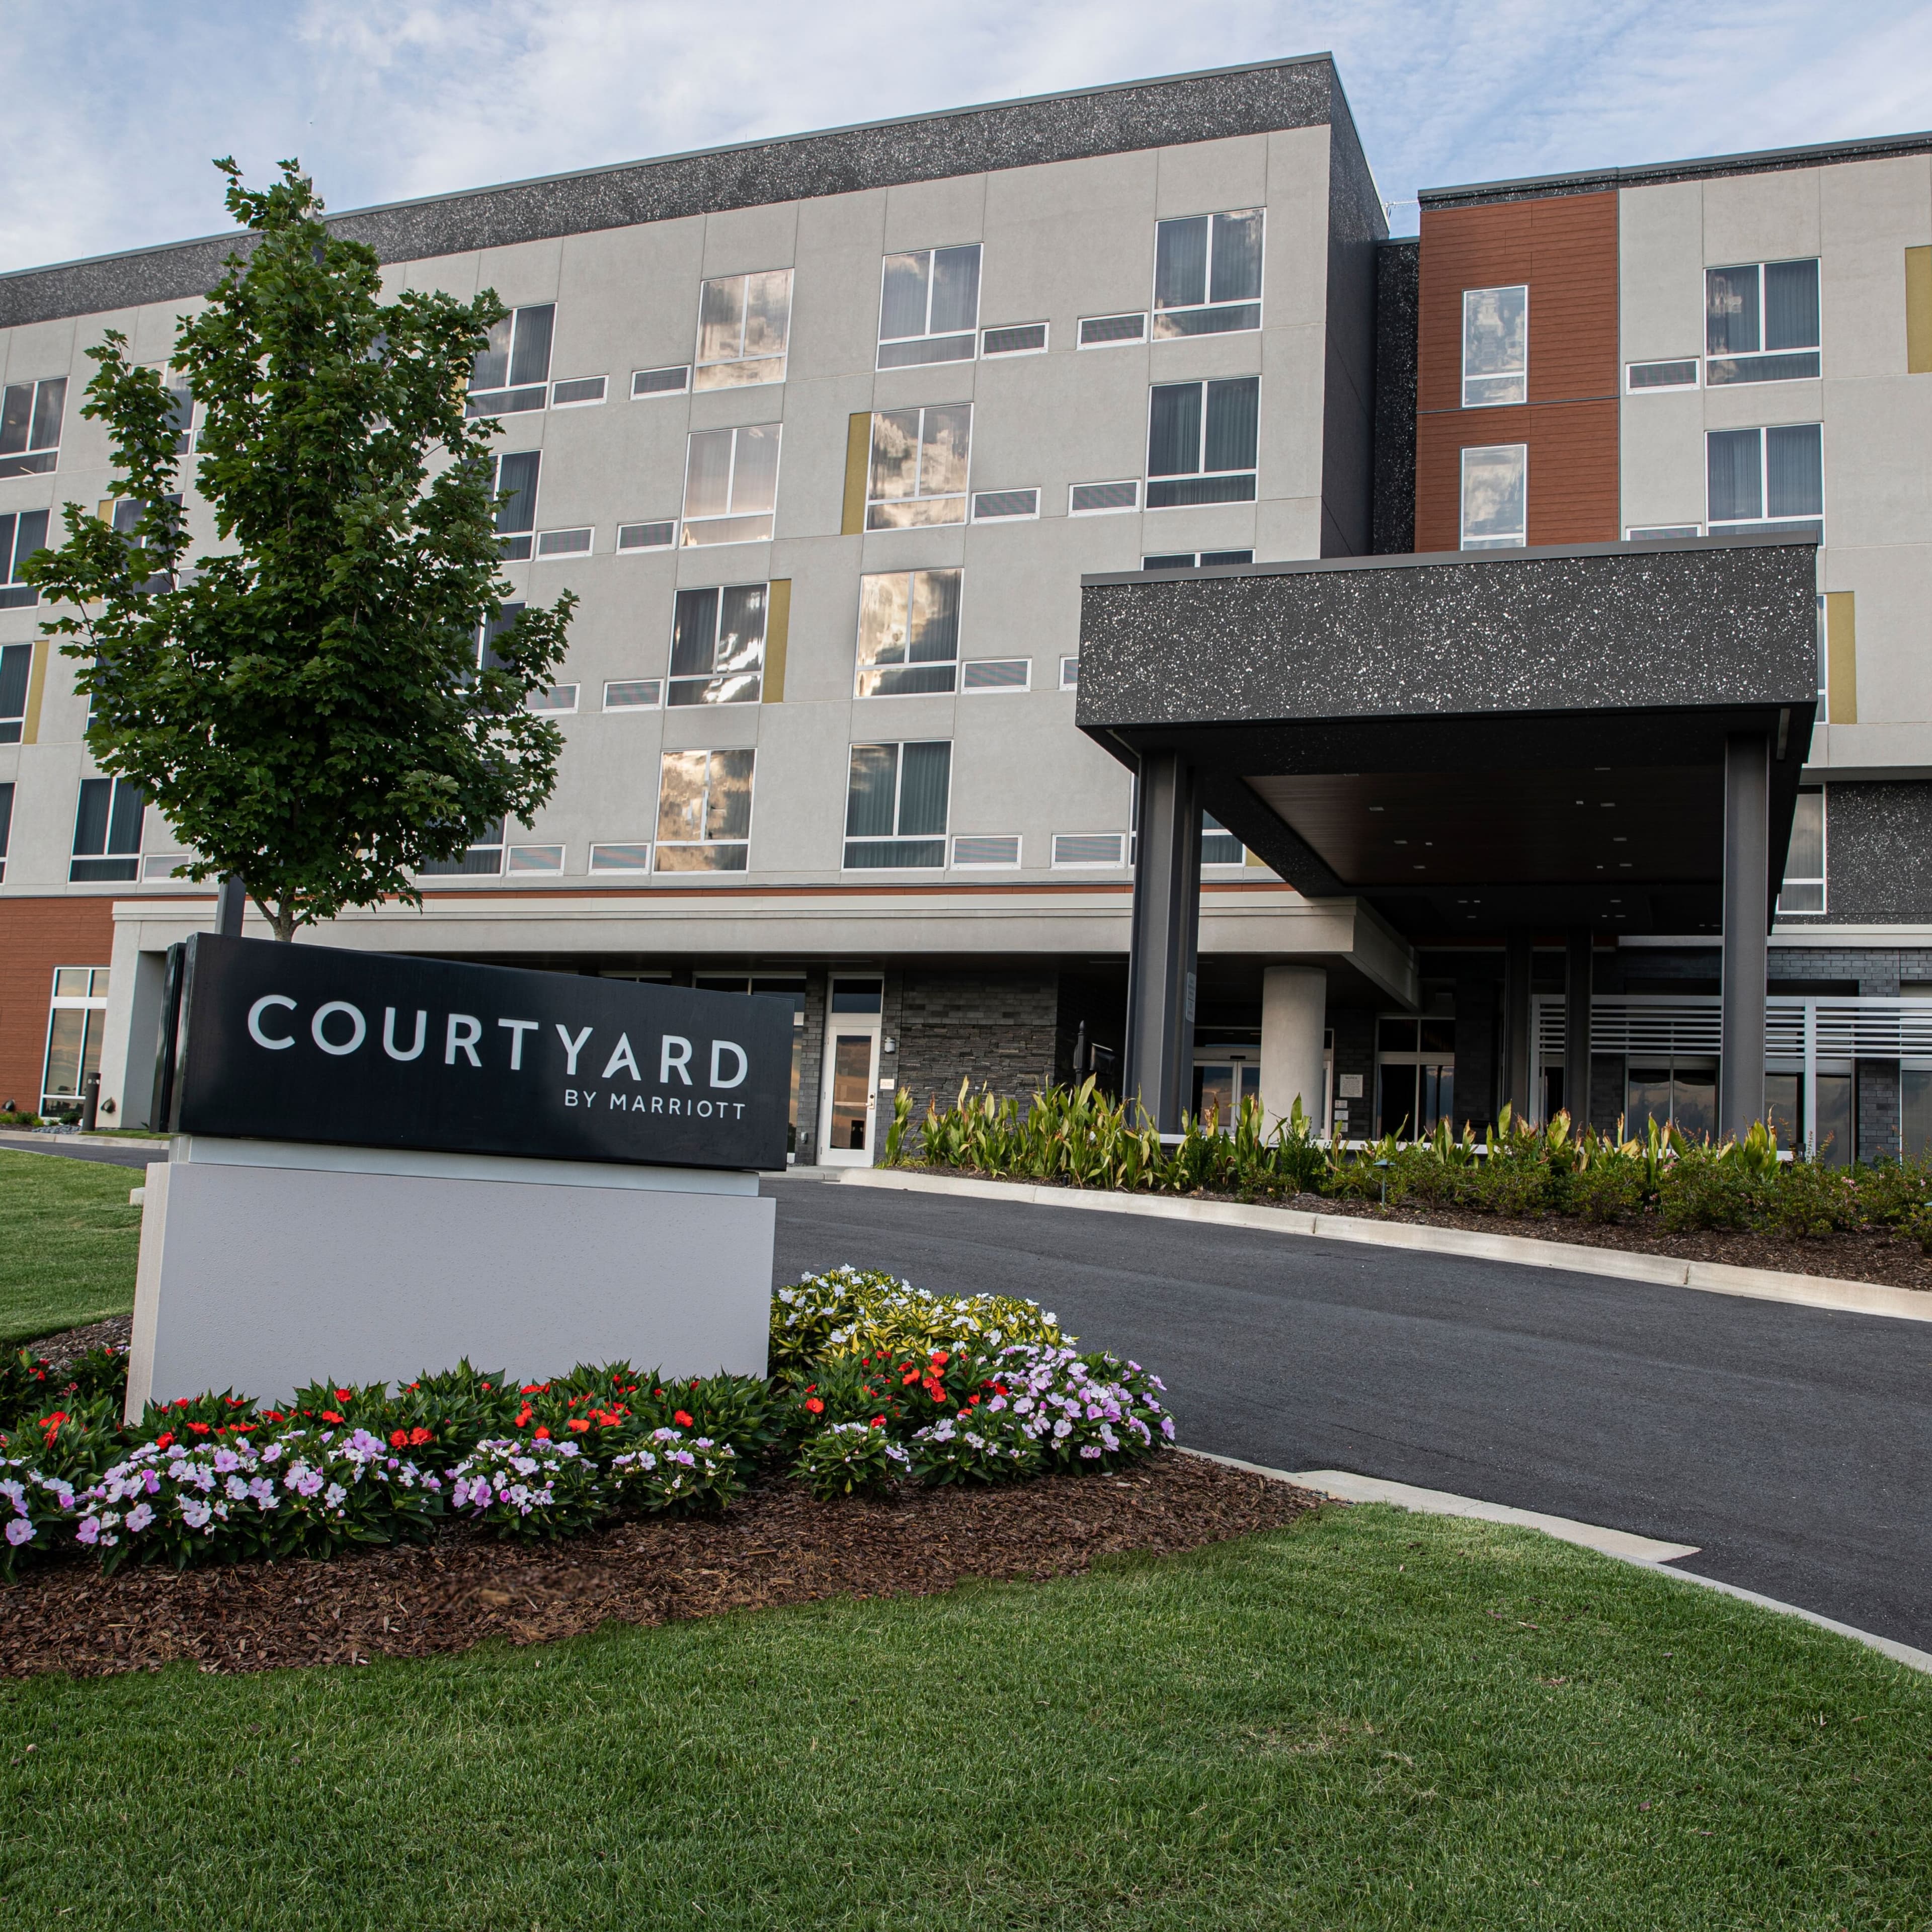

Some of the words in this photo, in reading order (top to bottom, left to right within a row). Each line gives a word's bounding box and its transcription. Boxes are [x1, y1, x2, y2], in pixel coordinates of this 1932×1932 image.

[247, 994, 749, 1089] COURTYARD
[565, 1089, 597, 1107] BY
[610, 1093, 746, 1120] MARRIOTT
